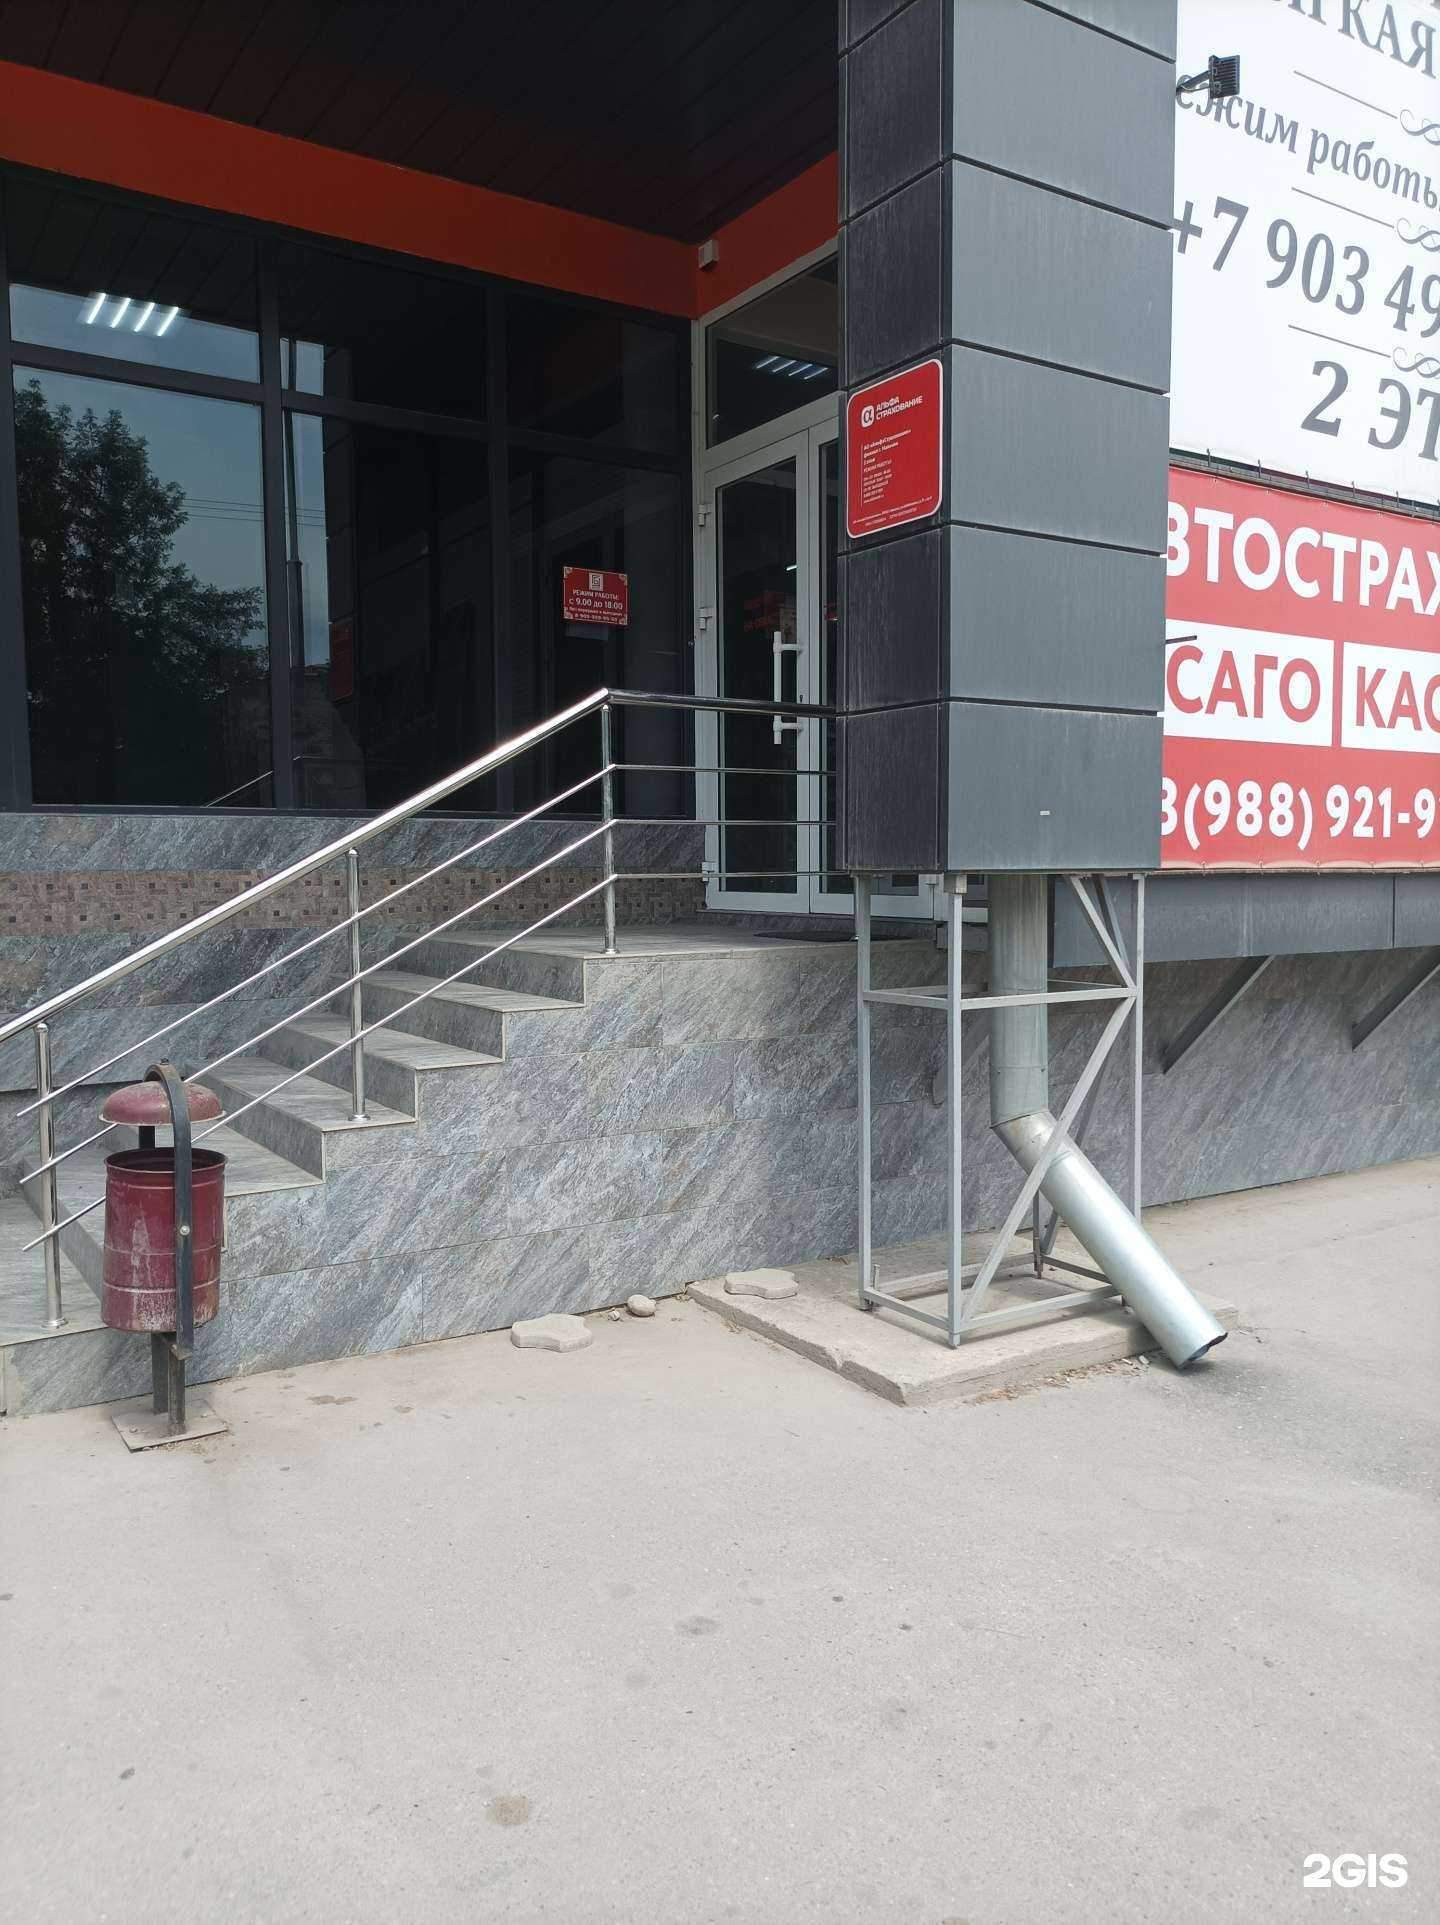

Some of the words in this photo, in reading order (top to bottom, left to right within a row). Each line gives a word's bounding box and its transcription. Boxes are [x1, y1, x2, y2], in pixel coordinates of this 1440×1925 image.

[1273, 0, 1437, 79] КАЯ
[1172, 196, 1249, 272] +7
[1265, 218, 1370, 316] 903
[876, 396, 900, 411] АЛЬФА
[876, 395, 923, 420] СТРАХОВАНИЕ
[1300, 360, 1349, 437] 2
[1367, 378, 1440, 461] ЭТ
[572, 589, 594, 598] РЕЖИМ
[575, 597, 592, 606] 9.00
[604, 601, 623, 610] 18.00
[1166, 644, 1321, 723] САГО
[1325, 784, 1440, 839] 921-9
